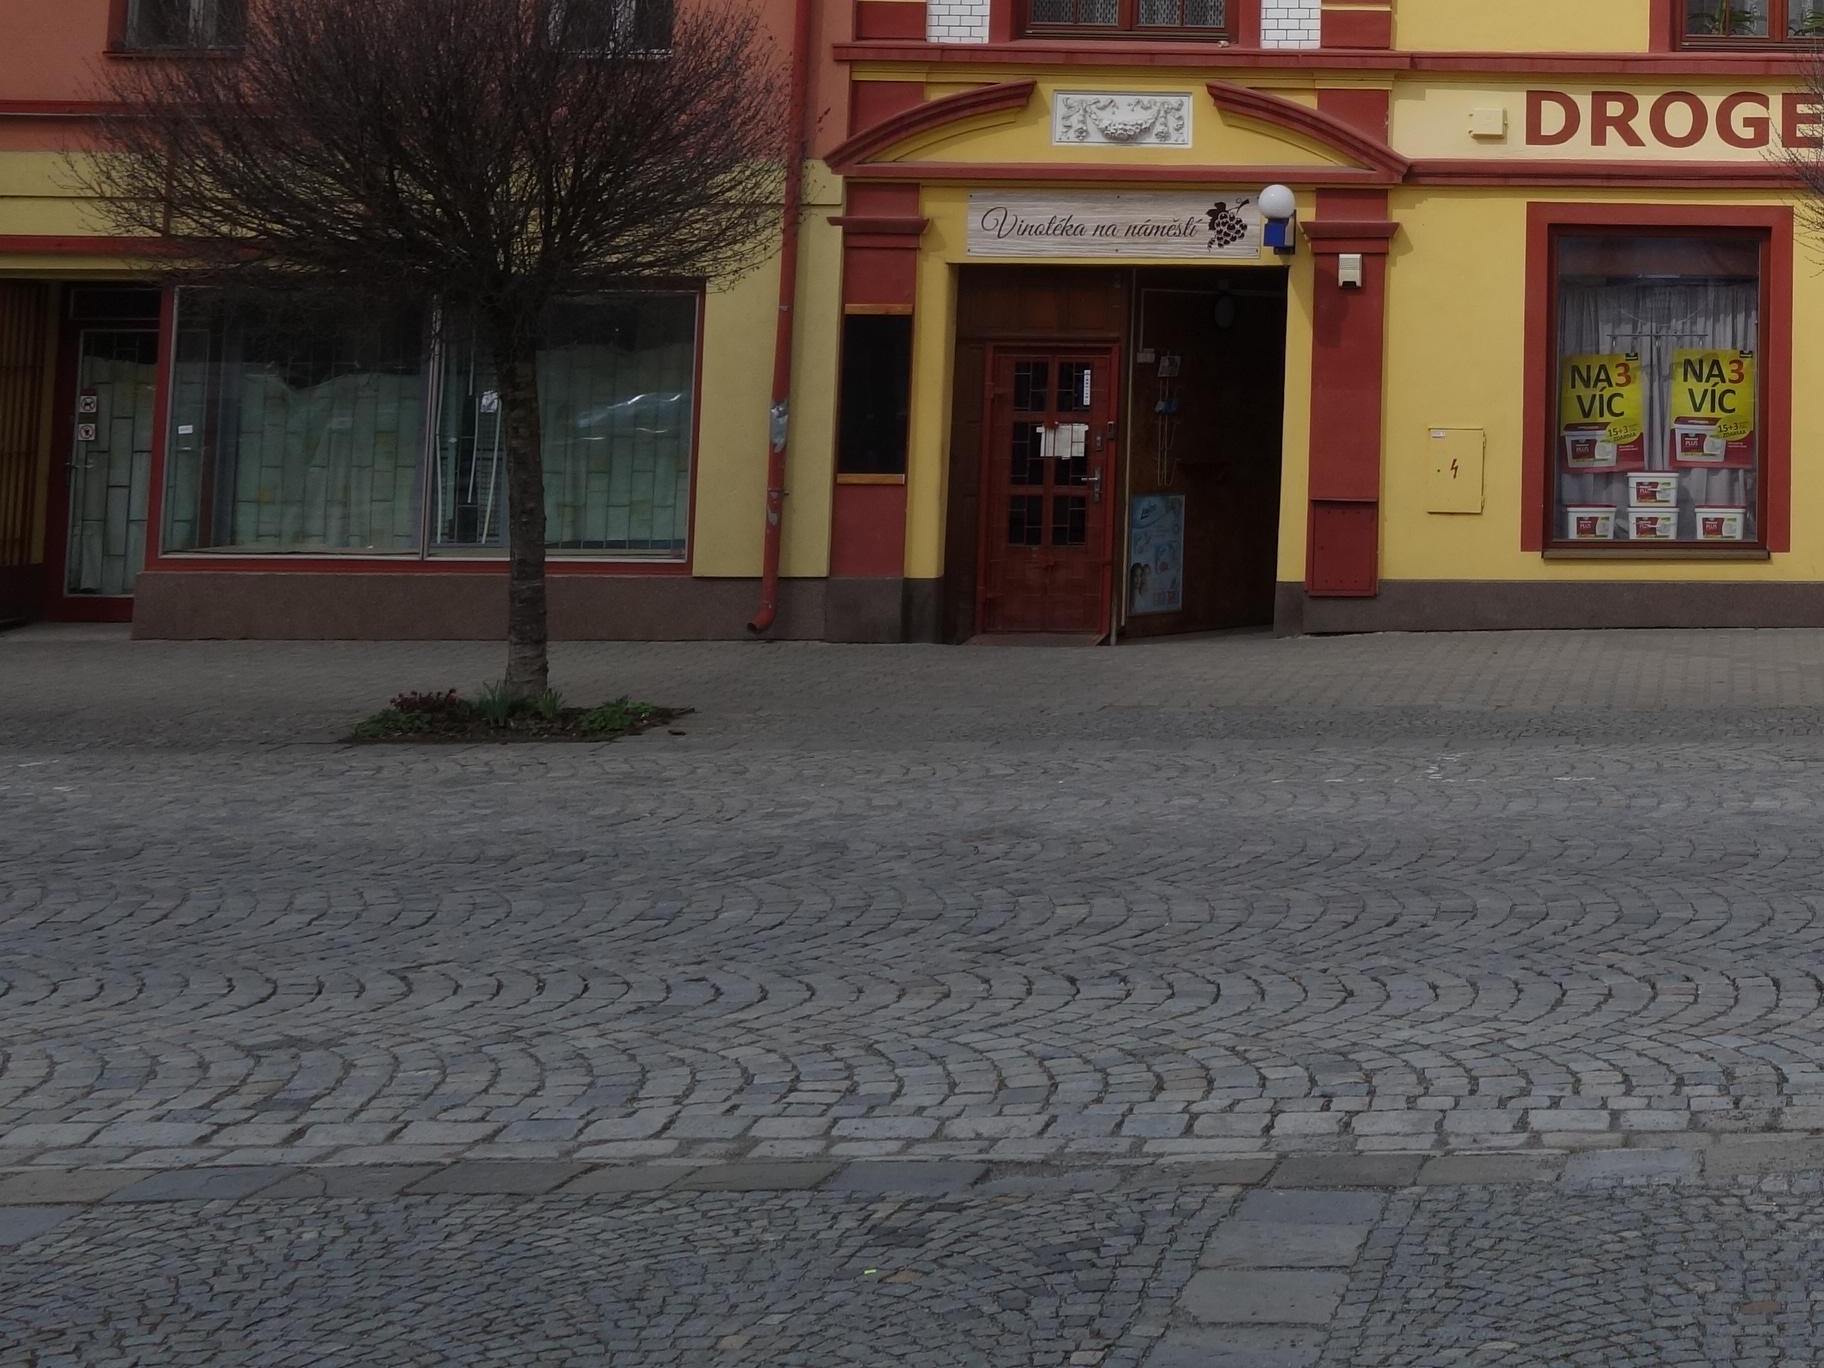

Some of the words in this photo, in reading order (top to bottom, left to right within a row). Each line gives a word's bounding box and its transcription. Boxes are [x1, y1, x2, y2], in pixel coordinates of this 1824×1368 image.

[981, 206, 1085, 239] Vinotéka
[1092, 222, 1118, 238] na
[1124, 216, 1204, 238] náměstí
[1576, 386, 1625, 419] VÍC
[1688, 382, 1736, 414] VÍC
